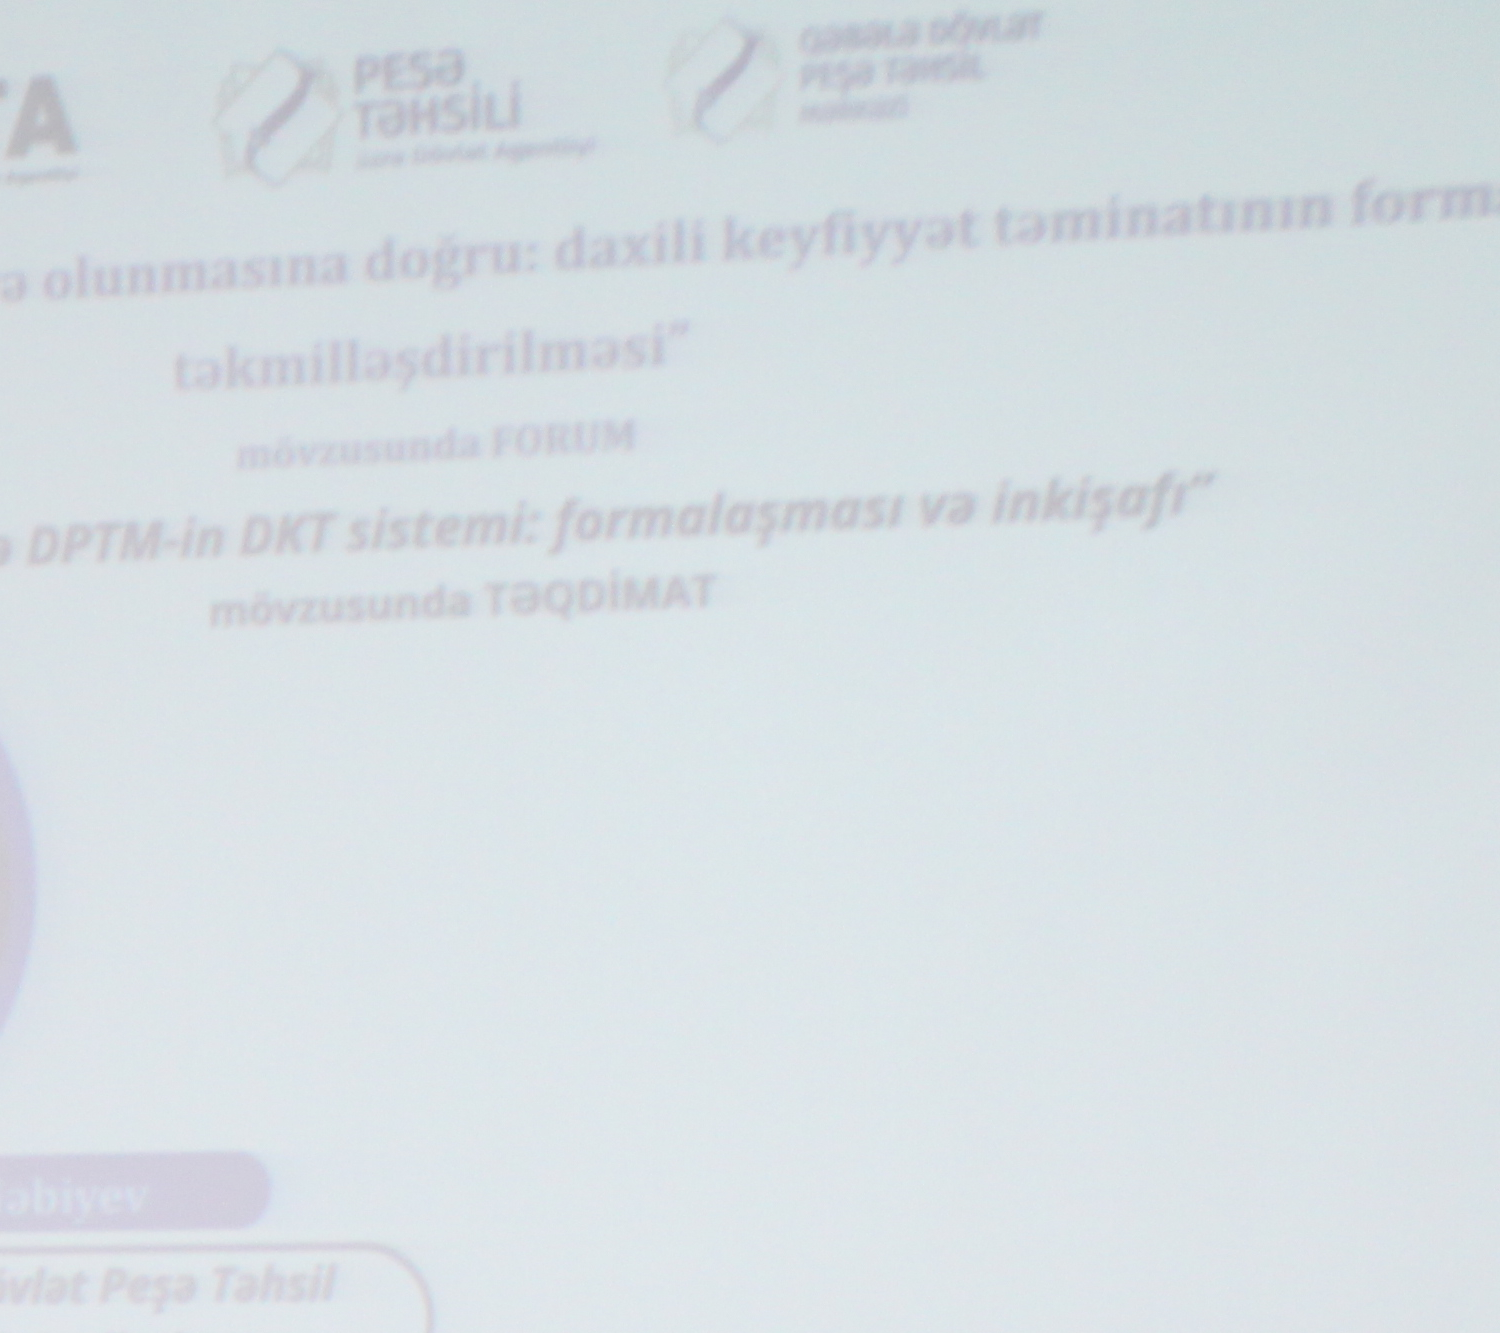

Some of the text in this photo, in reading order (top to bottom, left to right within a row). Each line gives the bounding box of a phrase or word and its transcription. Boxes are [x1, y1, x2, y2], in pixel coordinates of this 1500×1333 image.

[42, 254, 350, 303] olunmasına
[364, 234, 540, 292] doğru:
[553, 216, 707, 272] daxili
[722, 205, 979, 272] keyfiyyət
[994, 190, 1335, 249] təminatının
[1350, 176, 1500, 229] form
[236, 420, 637, 471] mövzusunda FORUM
[26, 517, 225, 568] DPTM-in
[239, 510, 337, 557] DKT
[346, 502, 542, 554] sistemi:
[548, 490, 904, 557] formalaşması
[920, 492, 979, 527] və
[209, 572, 717, 630] mövzusunda TƏQDİMAT
[100, 1266, 200, 1315] Peşə
[211, 1262, 340, 1304] Təhsil
